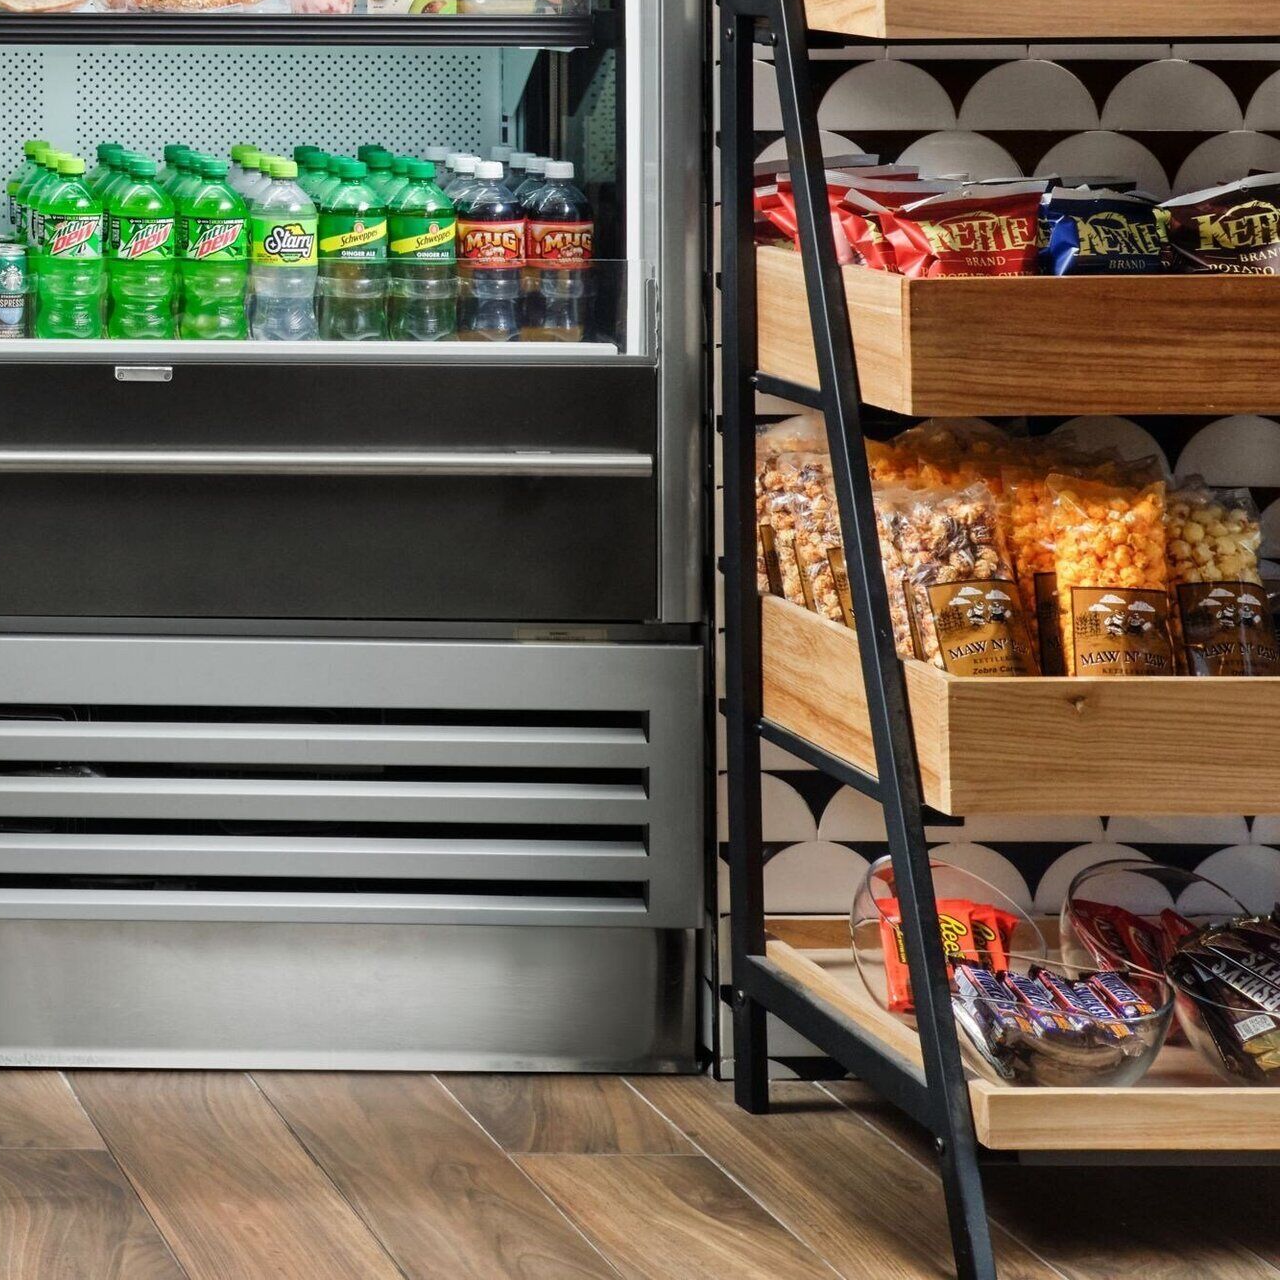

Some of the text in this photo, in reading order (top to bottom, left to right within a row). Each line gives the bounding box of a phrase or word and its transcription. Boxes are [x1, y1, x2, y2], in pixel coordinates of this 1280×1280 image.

[341, 230, 378, 246] Schweppes
[466, 232, 517, 252] MUG
[915, 215, 1036, 252] KETTLE
[266, 228, 314, 258] Starry
[965, 256, 1006, 266] BRAND
[1080, 651, 1119, 667] MAW
